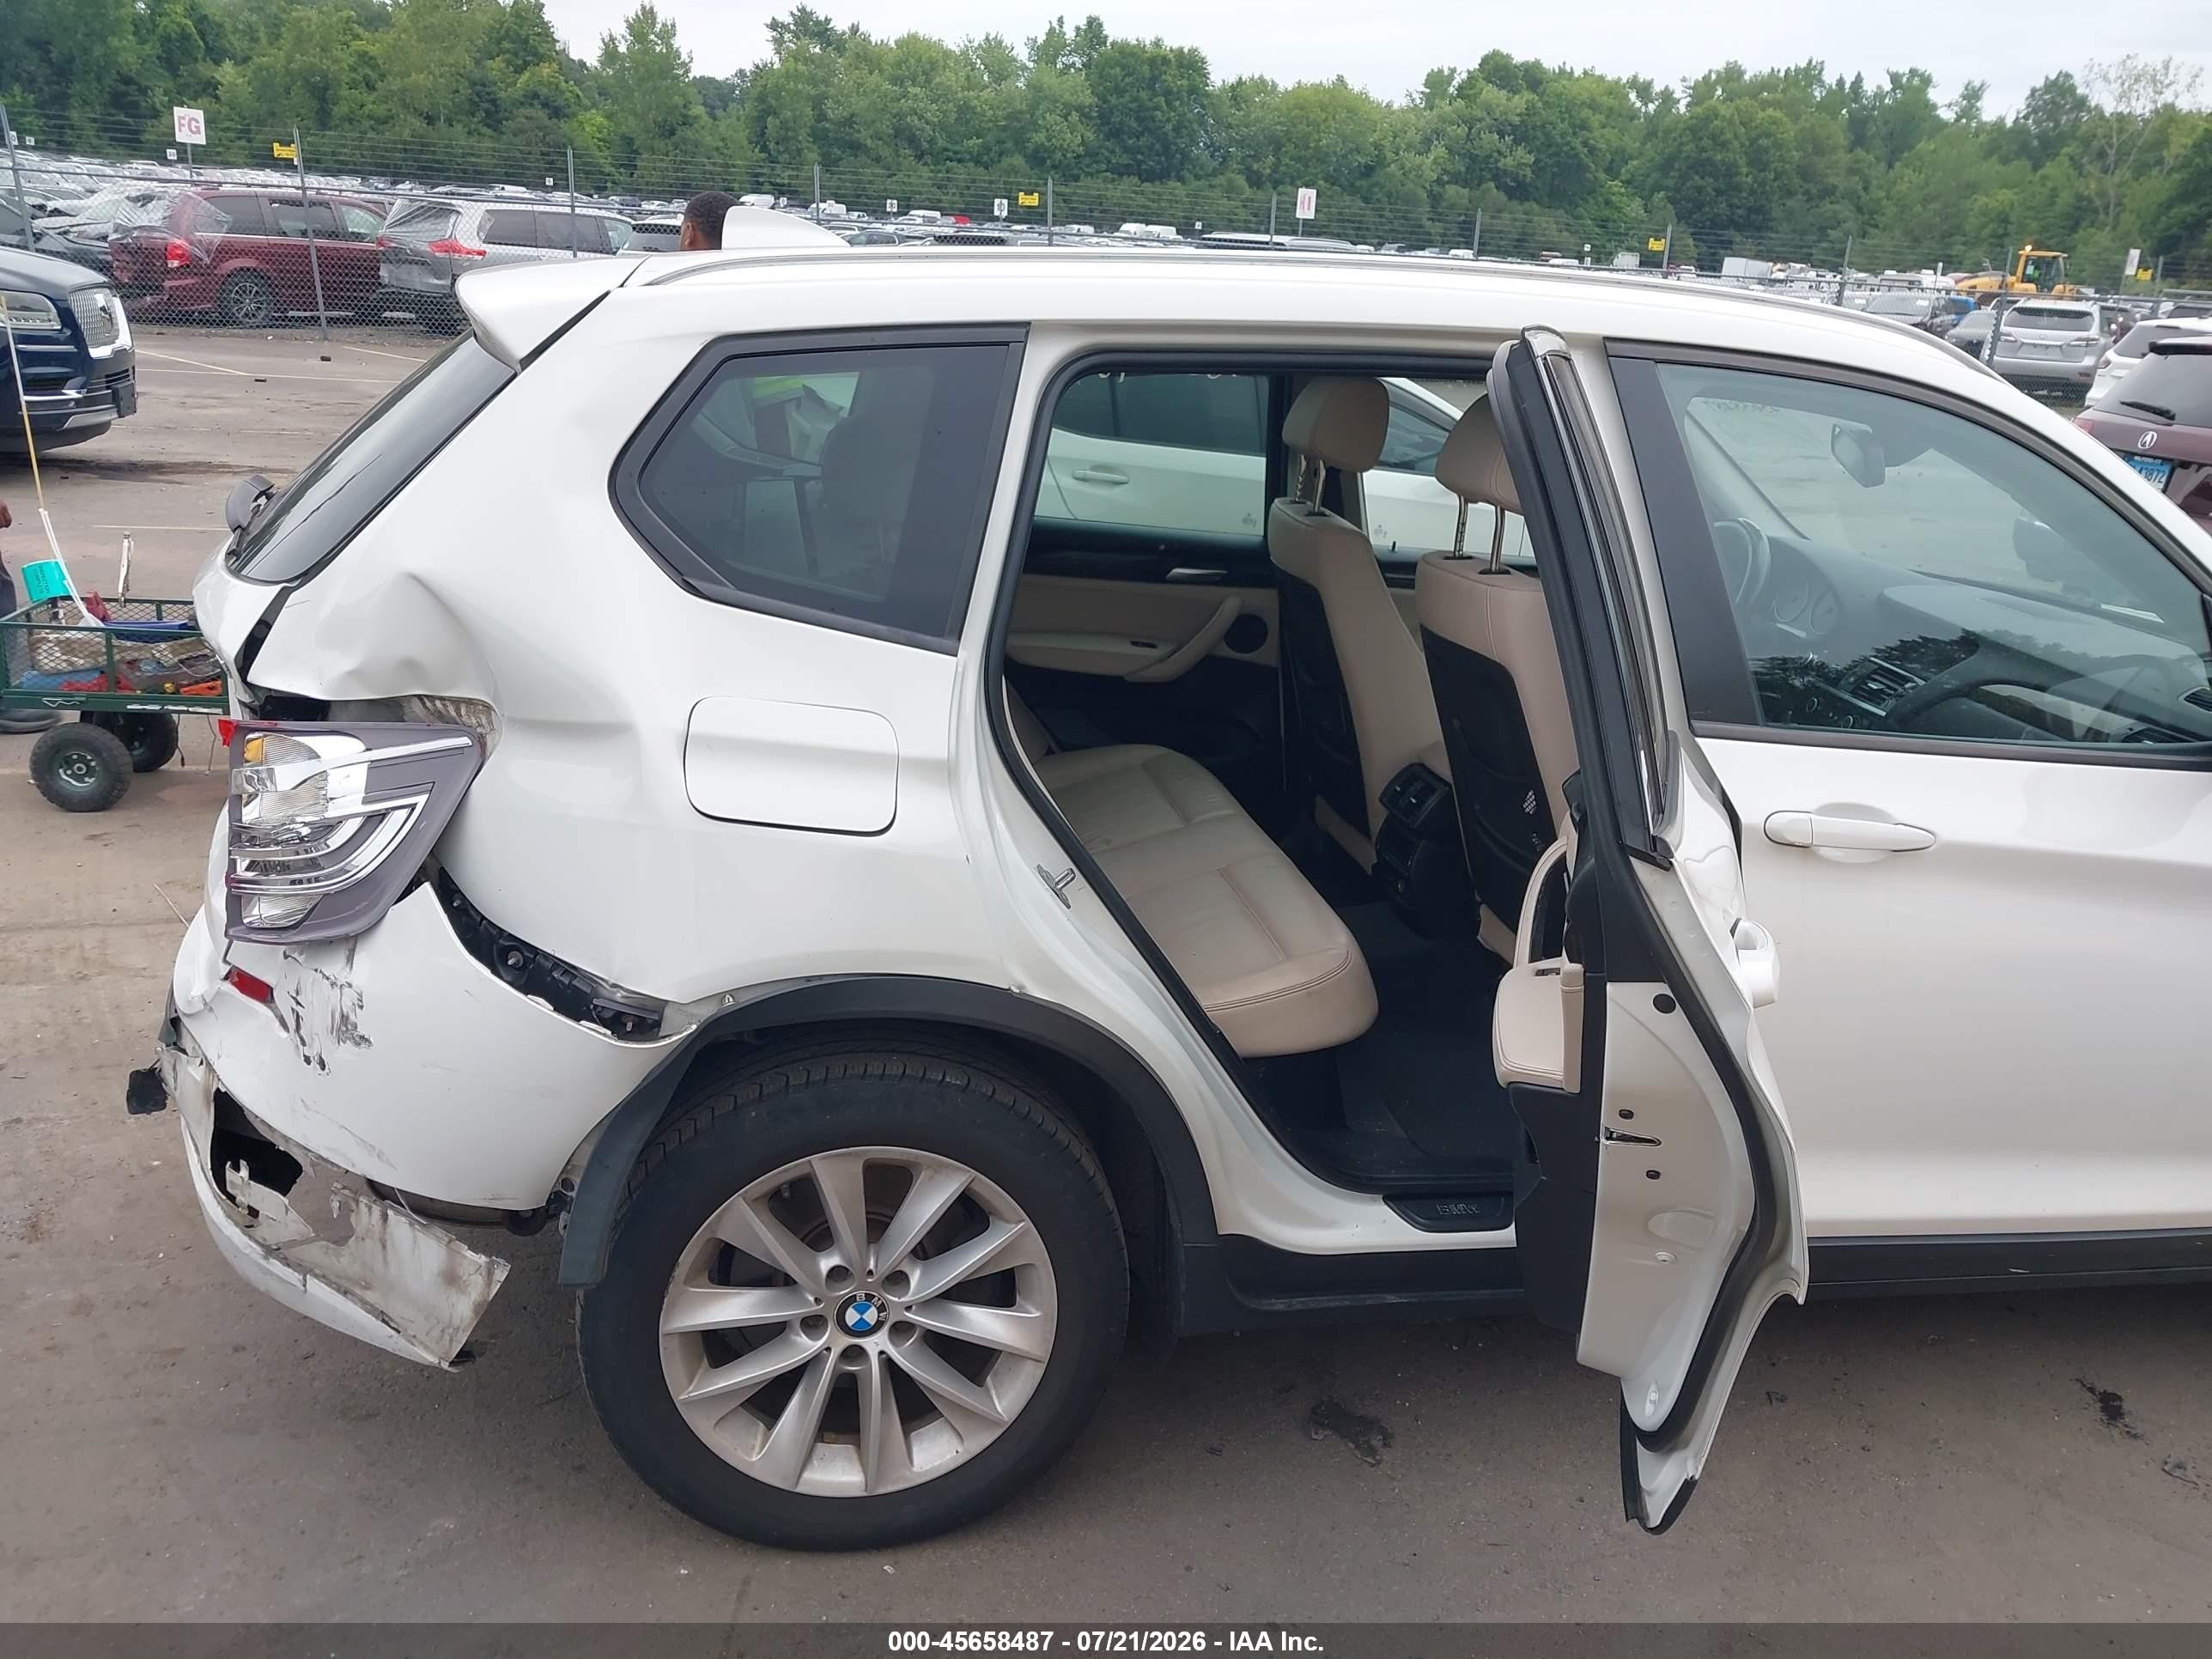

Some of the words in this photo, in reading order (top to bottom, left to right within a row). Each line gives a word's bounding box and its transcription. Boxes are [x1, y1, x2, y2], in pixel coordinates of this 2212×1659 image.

[177, 115, 201, 135] FG
[1436, 1203, 1481, 1215] BMW
[856, 1292, 888, 1322] BMW
